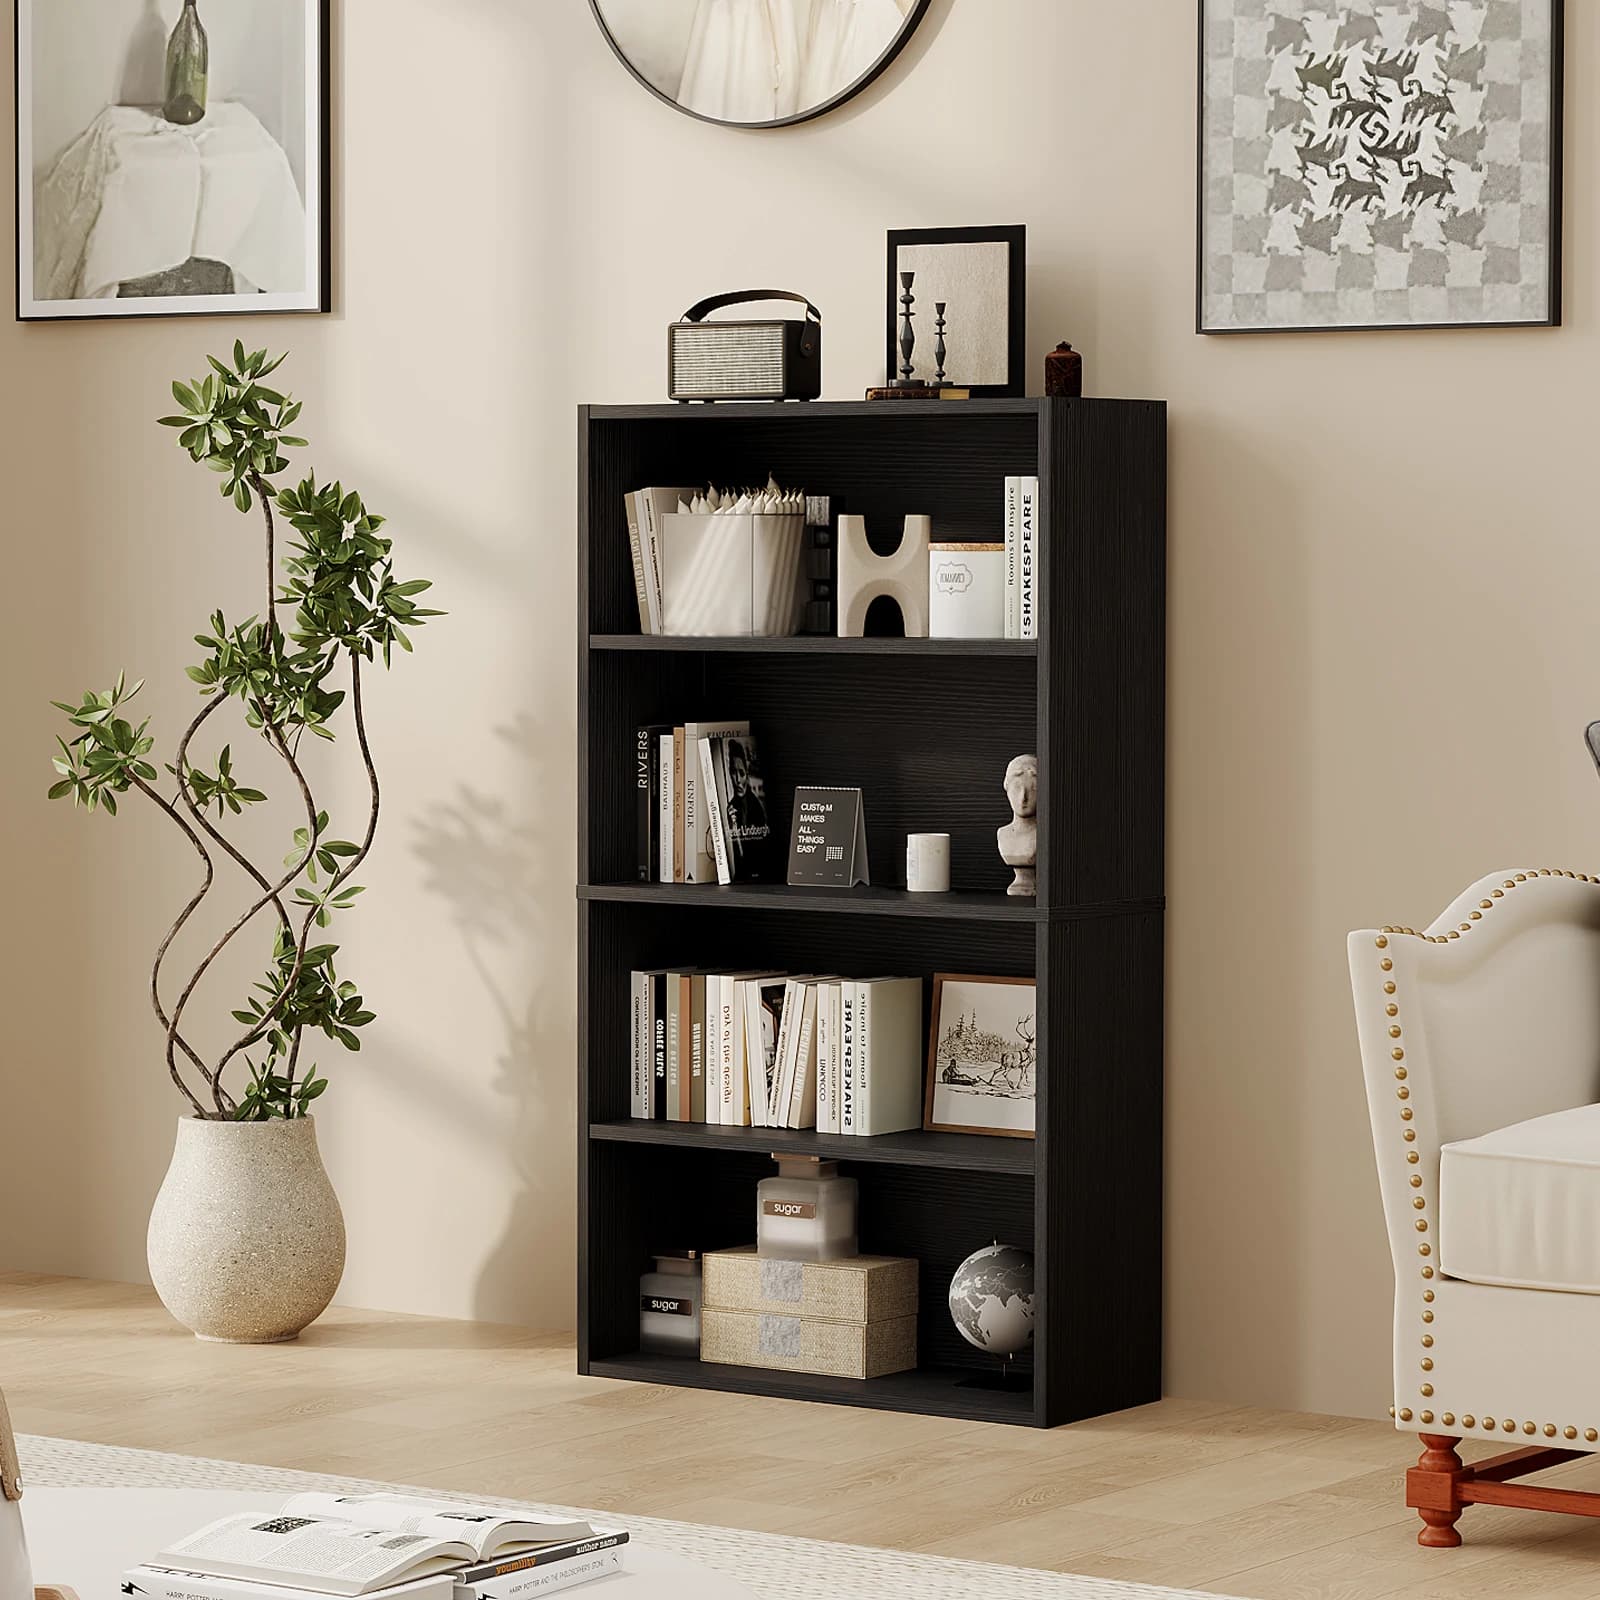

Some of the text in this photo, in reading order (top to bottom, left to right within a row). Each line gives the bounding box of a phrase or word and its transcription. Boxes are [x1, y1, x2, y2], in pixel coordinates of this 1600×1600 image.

[1007, 487, 1016, 586] Rooms to Inspire
[1023, 494, 1032, 627] SHAKESPEARE
[637, 731, 648, 789] RIVERS
[687, 780, 695, 829] KINFOLK
[709, 801, 721, 843] Lindbergh
[799, 814, 825, 823] MAKES
[741, 824, 770, 837] Lindbergh
[797, 835, 825, 844] THINGS
[797, 845, 816, 853] EASY
[773, 1202, 802, 1216] sugar
[651, 1299, 679, 1312] sugar
[576, 1542, 599, 1554] author
[599, 1537, 617, 1549] name
